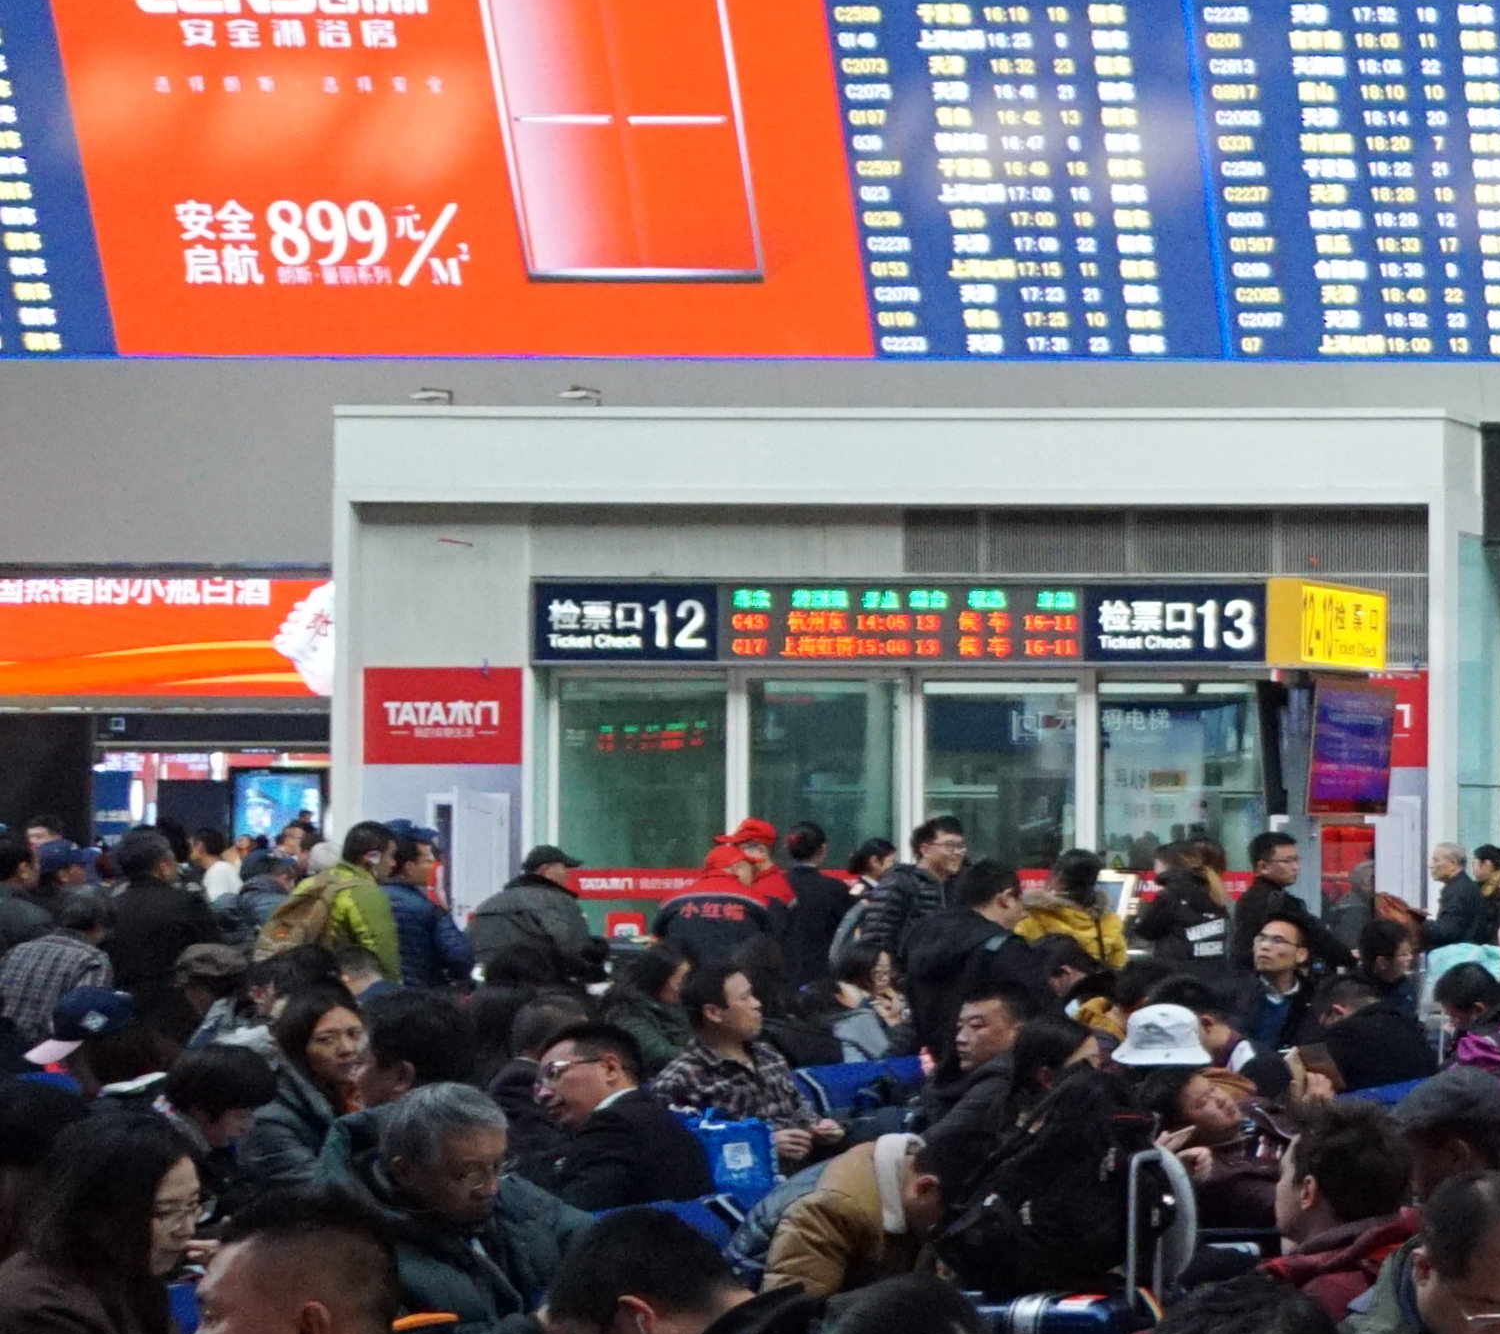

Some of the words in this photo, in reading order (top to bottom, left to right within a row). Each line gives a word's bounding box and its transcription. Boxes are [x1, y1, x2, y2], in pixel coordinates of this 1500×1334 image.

[180, 20, 398, 49] 安全淋浴房
[174, 200, 256, 240] 安全
[266, 200, 388, 266] 899
[184, 244, 264, 285] 启航
[548, 599, 643, 630] 检票口
[648, 599, 708, 648] 12
[1098, 599, 1194, 631] 检票口
[1197, 599, 1256, 648] 13
[1099, 635, 1143, 650] Ticket
[1145, 635, 1192, 650] Check
[382, 700, 500, 726] TATA木门
